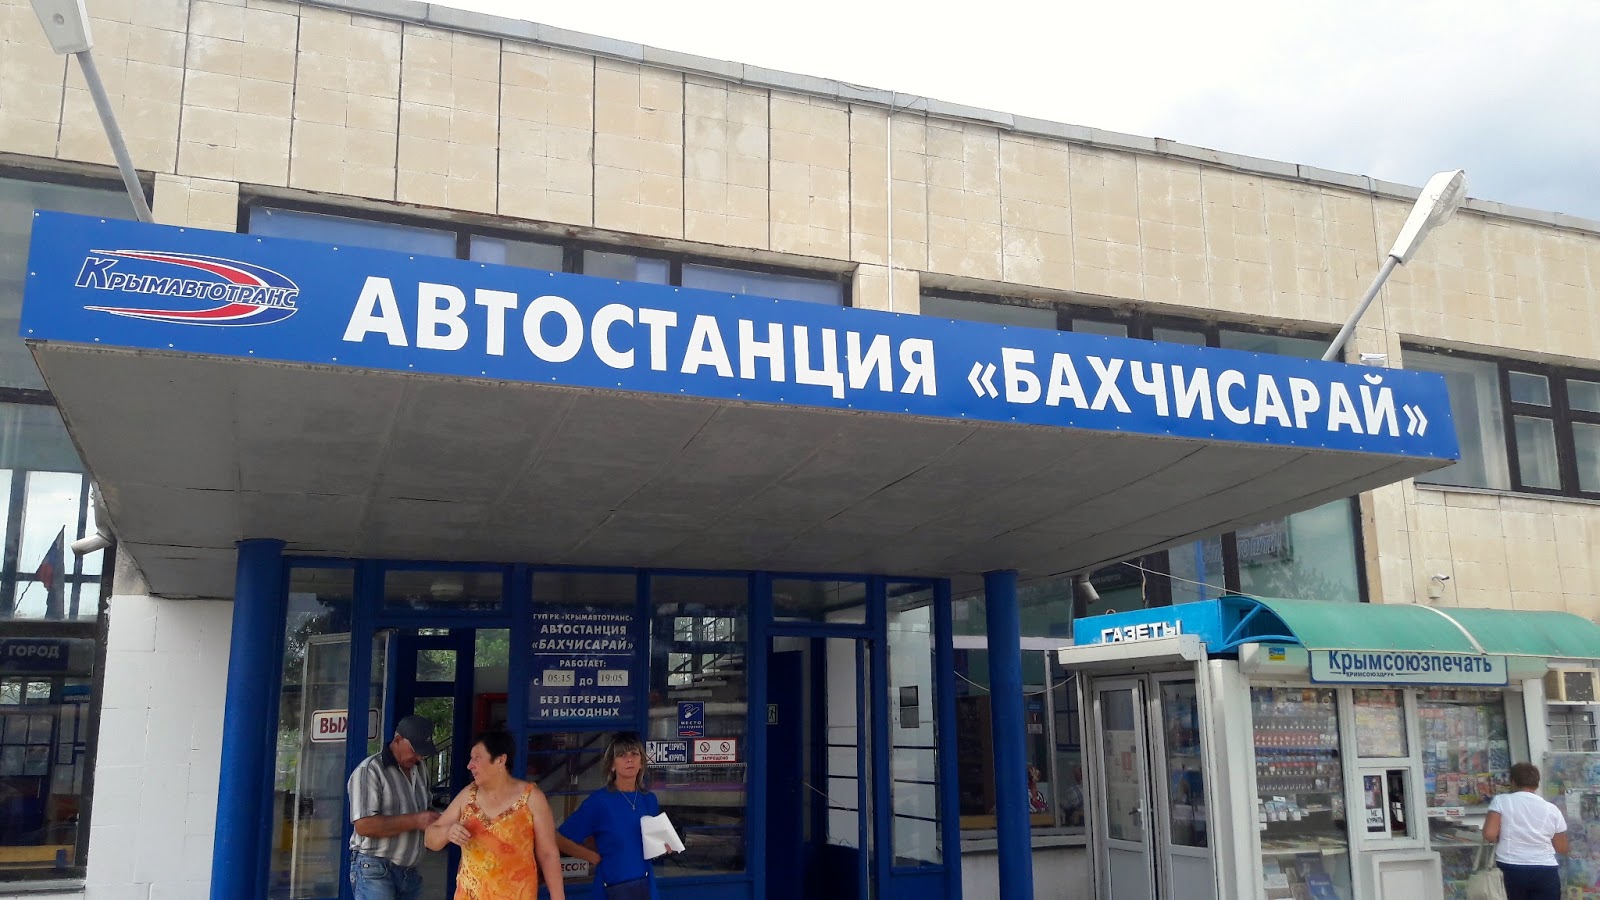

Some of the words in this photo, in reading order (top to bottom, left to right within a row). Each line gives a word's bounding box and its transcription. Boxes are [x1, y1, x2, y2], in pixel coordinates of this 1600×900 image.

[342, 276, 938, 399] АВТОСТАНЦИЯ
[967, 347, 1428, 438] «БАХЧИСАРАЙ»
[540, 624, 627, 636] АВТОСТАНЦИЯ
[1101, 619, 1182, 645] ГАЗЕТЫ
[531, 637, 633, 650] «БАХЧИСАРАЙ»
[8, 645, 60, 659] ГОРОД
[559, 659, 607, 668] РАБОТАЕТ:
[1328, 650, 1492, 675] Крымсоюзпечать
[547, 674, 571, 683] 05:15
[601, 673, 623, 682] 19:05
[540, 695, 560, 704] БЕЗ
[562, 695, 621, 704] ПЕРЕРЫВА
[541, 708, 549, 717] И
[552, 707, 619, 717] ВЫХОДНЫХ
[657, 743, 668, 762] НЕ
[560, 862, 587, 872] ЕСОК
